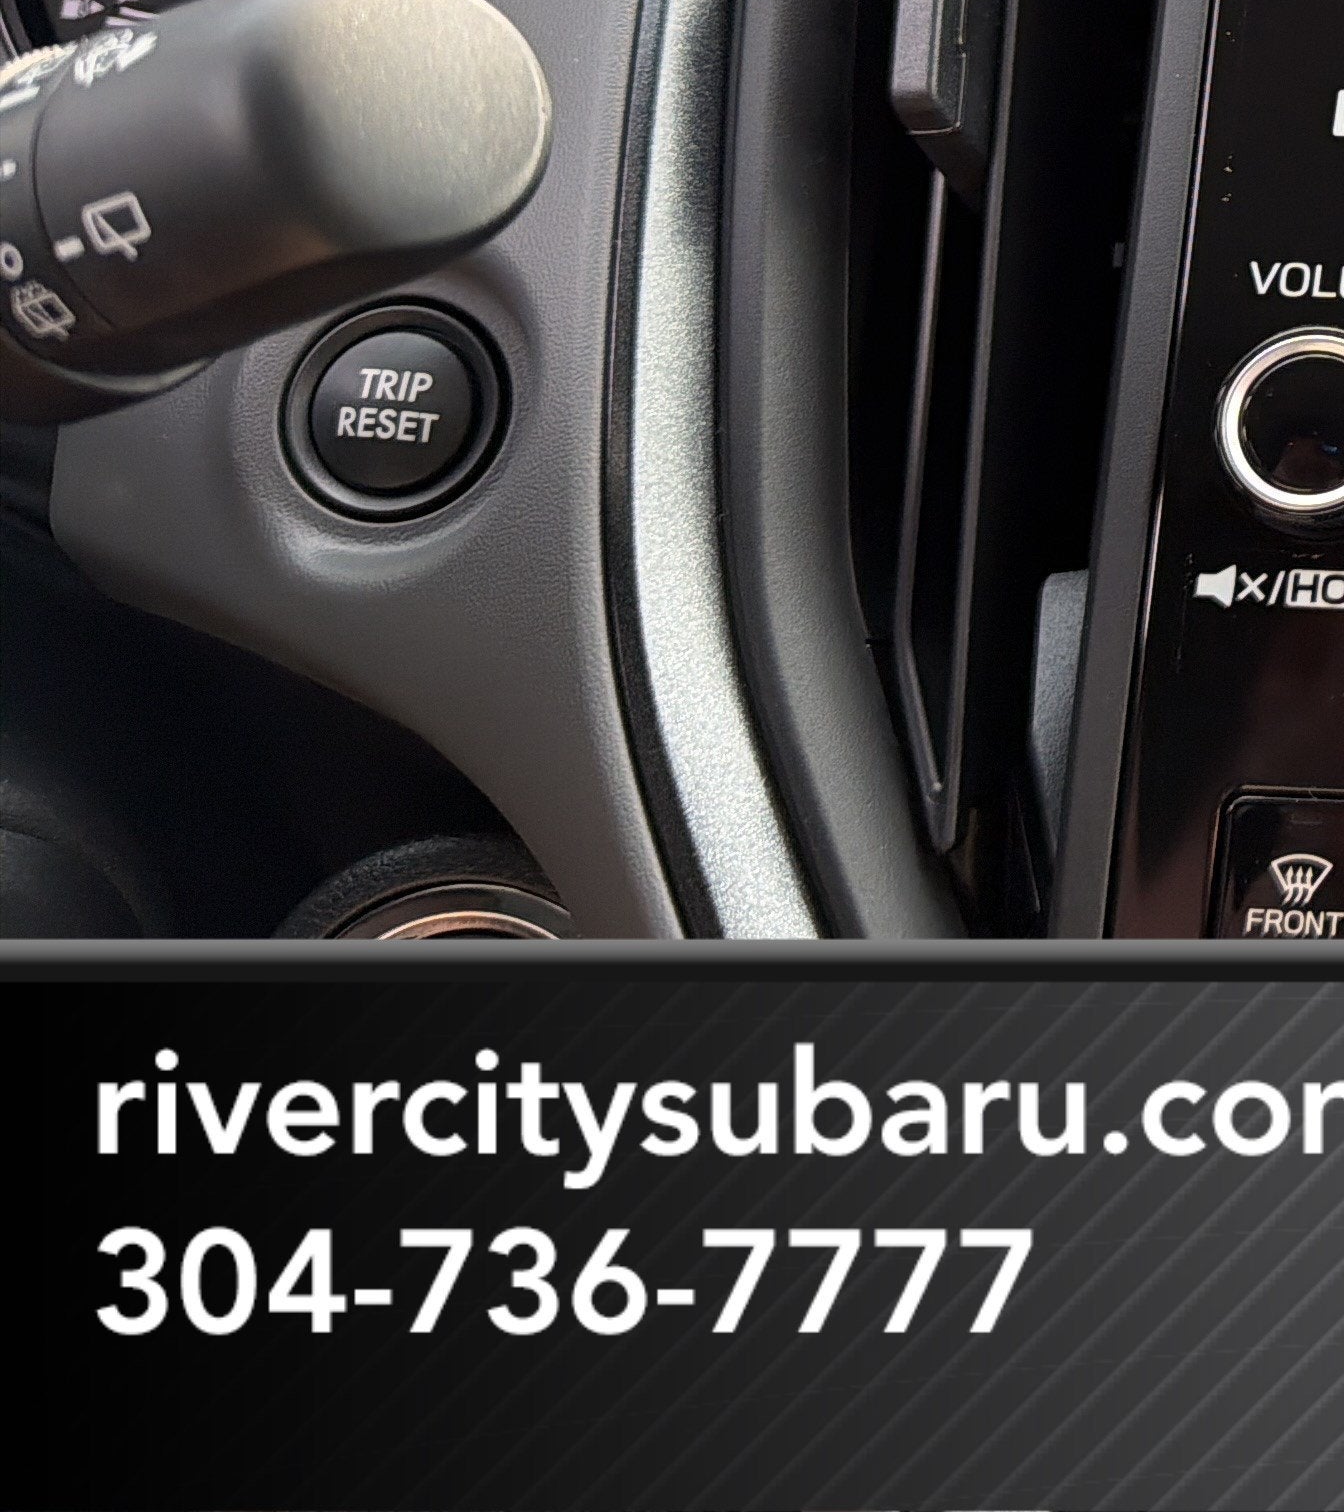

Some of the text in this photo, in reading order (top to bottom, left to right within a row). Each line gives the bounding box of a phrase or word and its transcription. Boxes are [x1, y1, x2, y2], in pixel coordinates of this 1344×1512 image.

[360, 368, 434, 402] TRIP
[337, 406, 440, 443] RESET
[1246, 908, 1344, 936] FRONT
